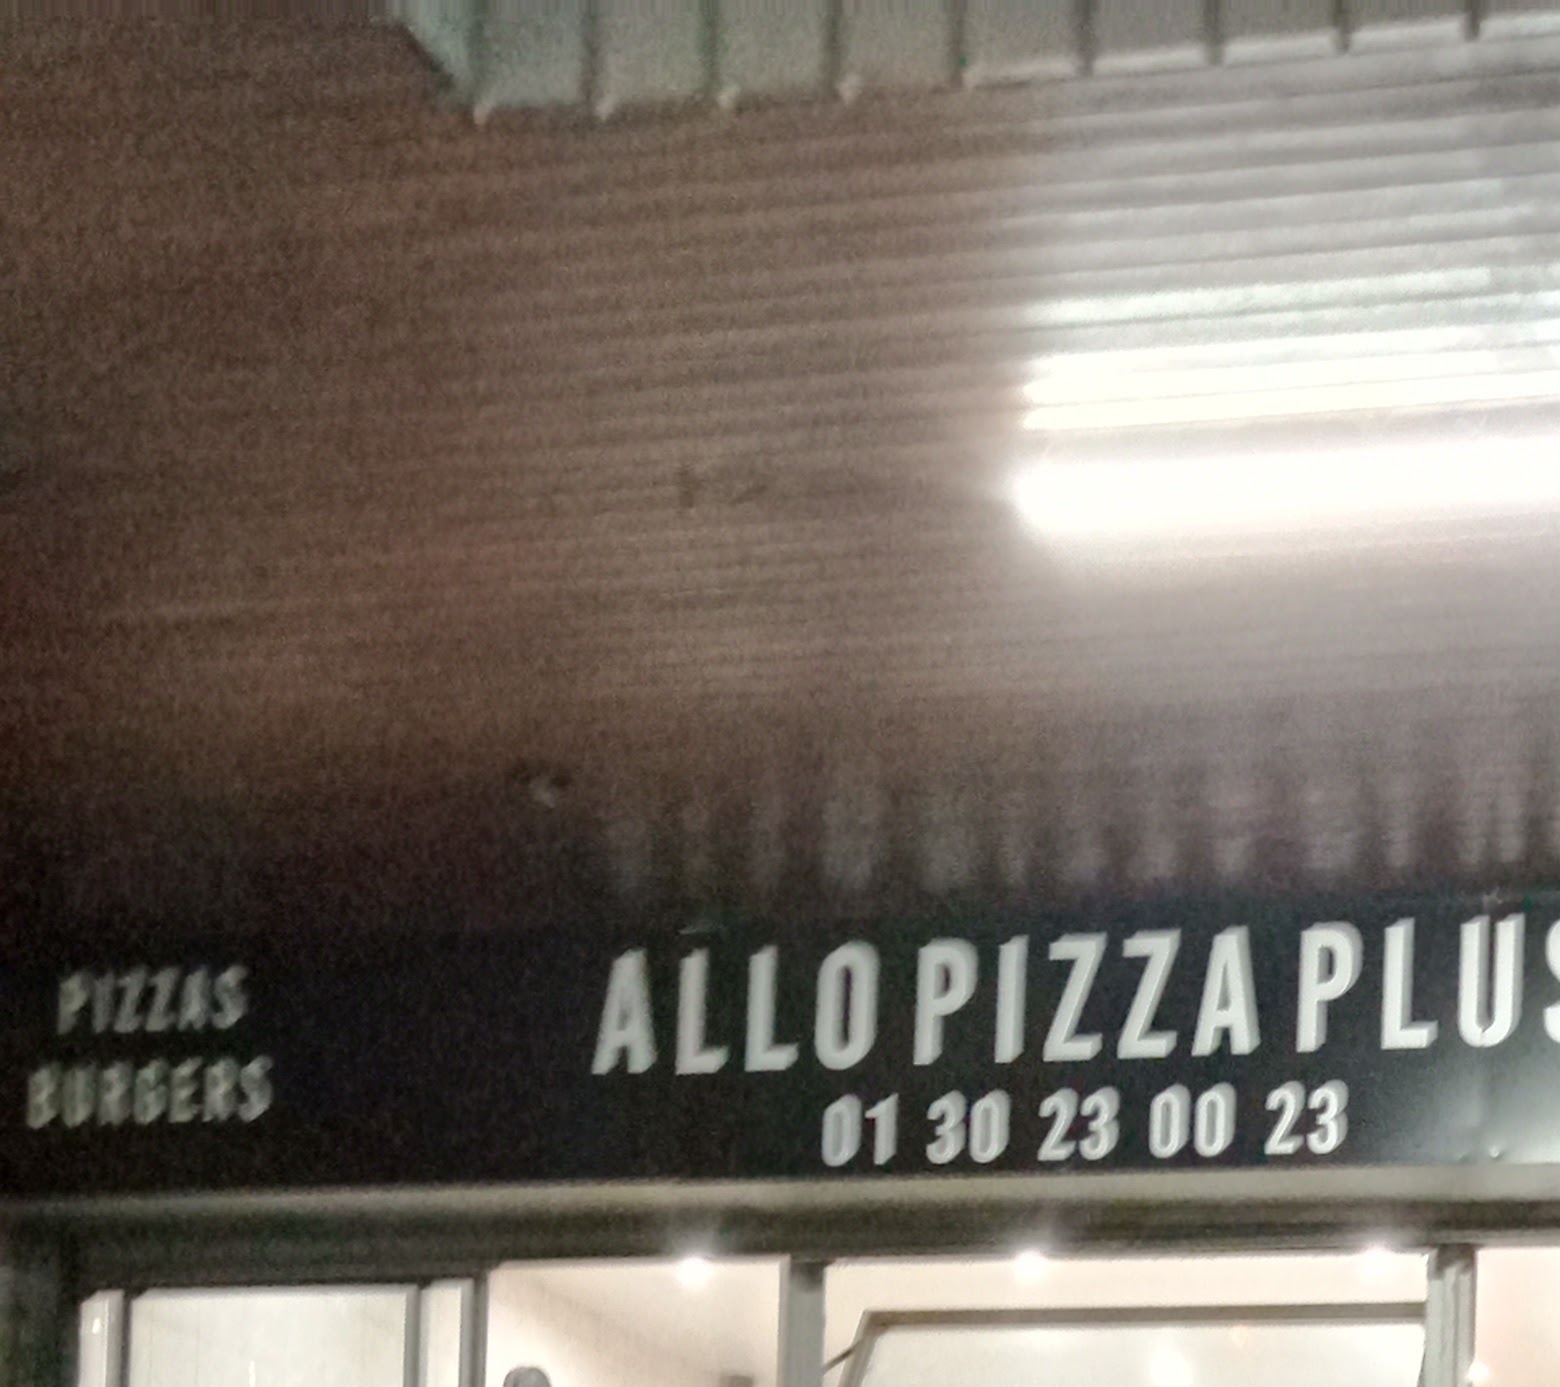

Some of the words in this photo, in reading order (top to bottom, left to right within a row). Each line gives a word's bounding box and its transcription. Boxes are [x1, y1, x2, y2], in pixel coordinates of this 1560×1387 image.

[56, 965, 250, 1034] PIZZAS
[593, 939, 880, 1075] ALLO
[914, 924, 1260, 1064] PIZZA
[25, 1056, 273, 1129] BURGERS
[821, 1092, 899, 1167] 01
[926, 1088, 1010, 1166] 30
[1038, 1085, 1120, 1161] 23
[1148, 1081, 1236, 1158] 00
[1264, 1078, 1348, 1155] 23
